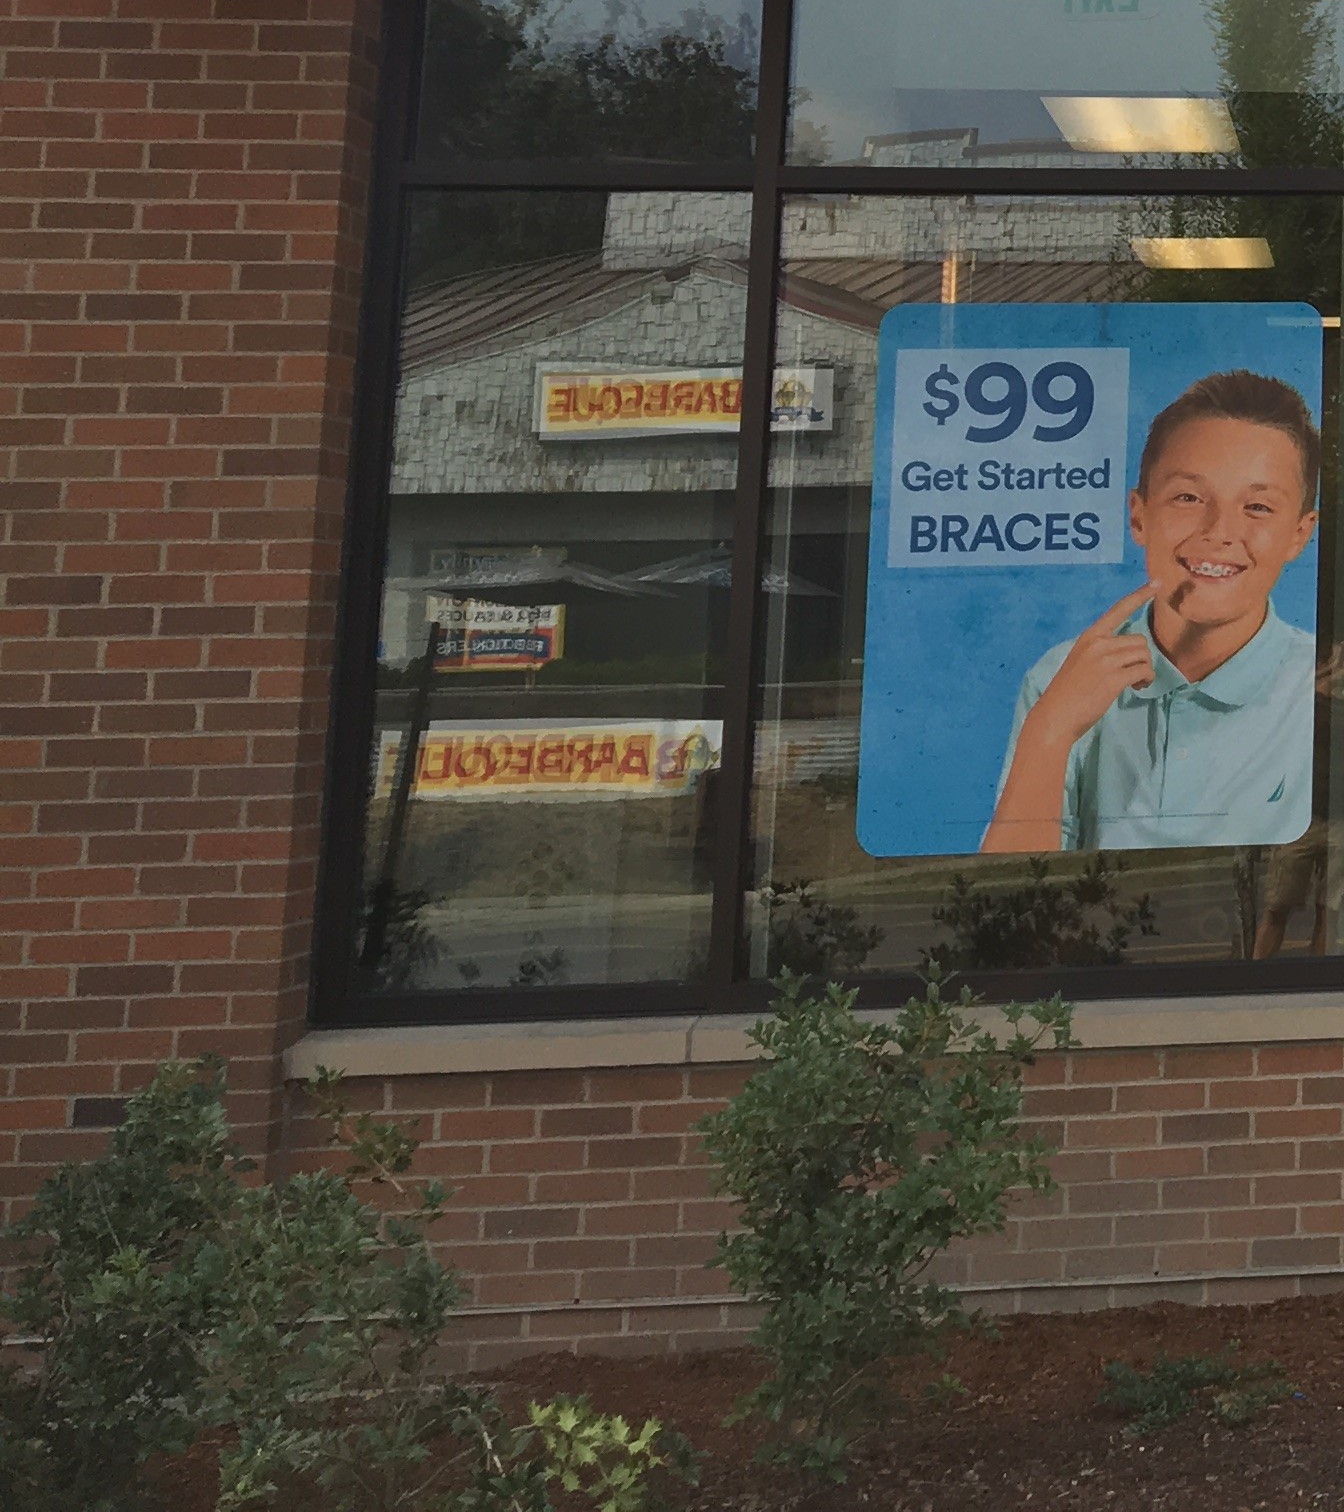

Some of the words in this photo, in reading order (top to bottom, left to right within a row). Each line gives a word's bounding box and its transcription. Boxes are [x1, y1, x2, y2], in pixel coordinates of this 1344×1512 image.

[922, 361, 1095, 443] $99
[901, 460, 968, 492] Get
[977, 458, 1110, 492] Started
[909, 512, 1100, 553] BRACES
